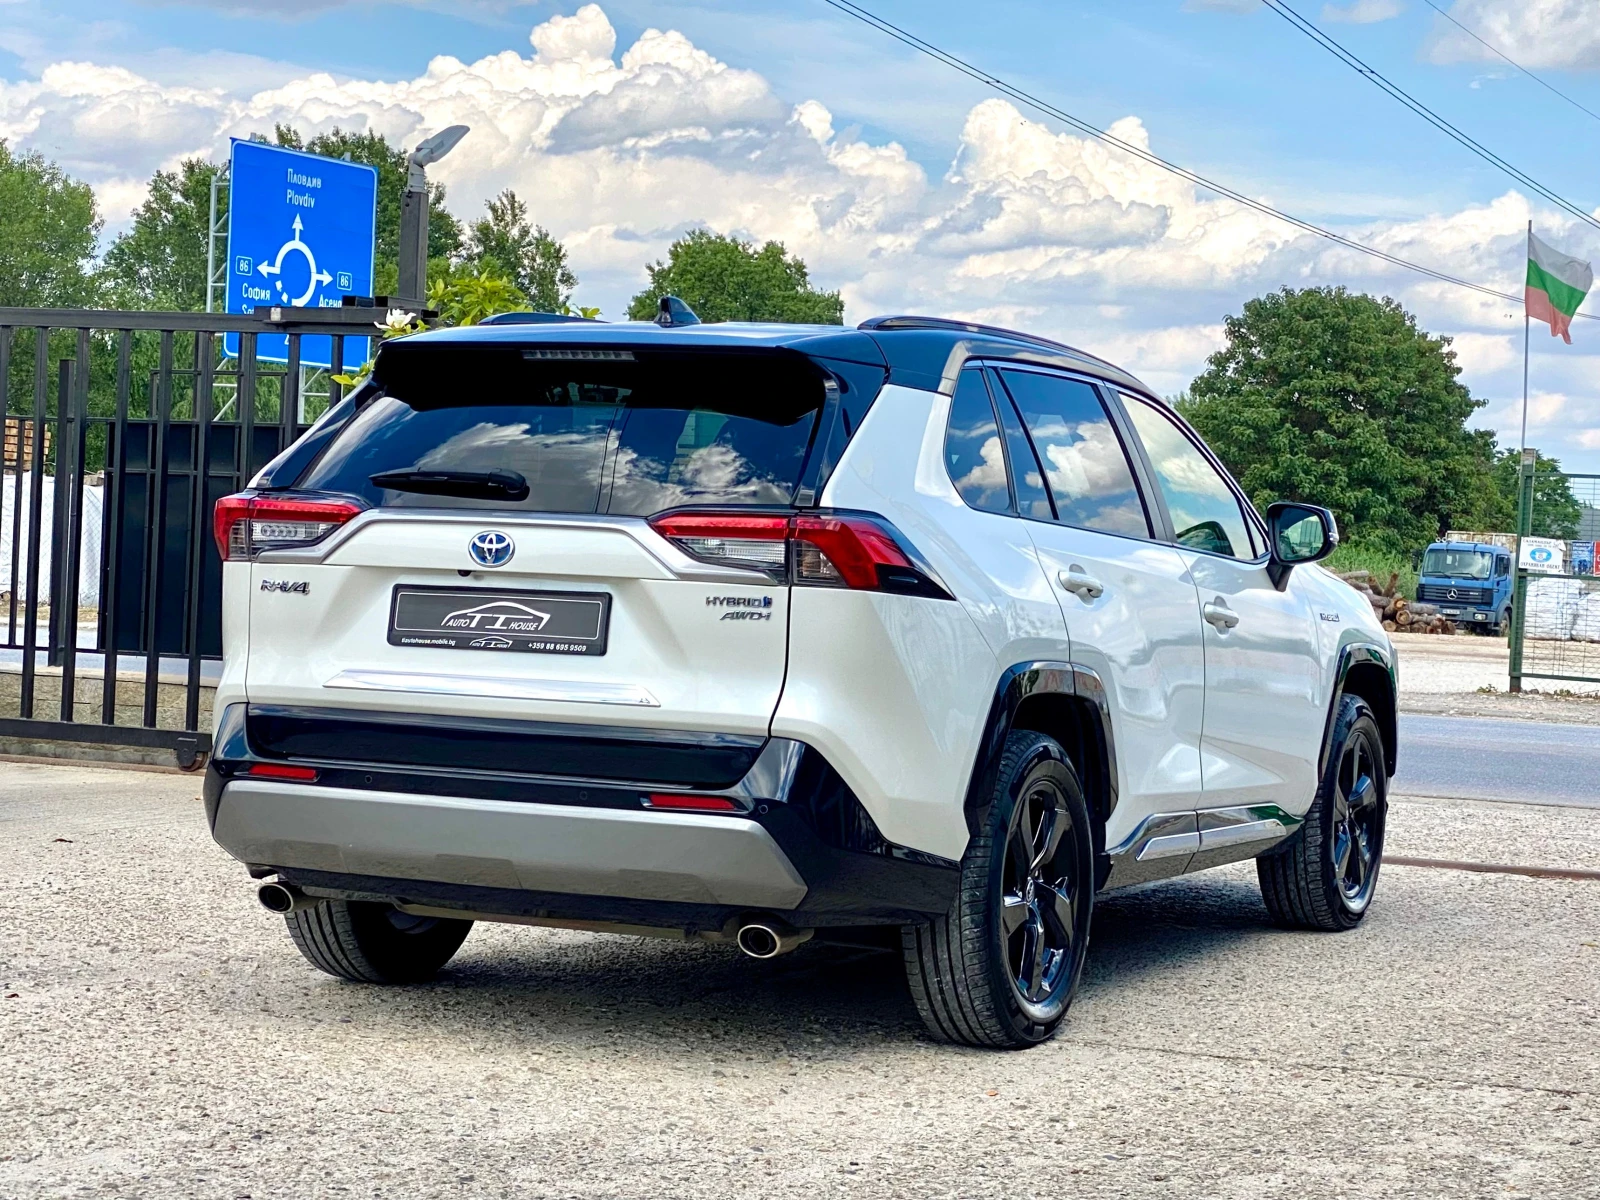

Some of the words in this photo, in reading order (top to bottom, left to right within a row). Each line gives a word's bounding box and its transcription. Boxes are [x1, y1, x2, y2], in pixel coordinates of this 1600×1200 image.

[287, 168, 322, 188] Пловдив
[286, 189, 315, 208] Plovdiv
[239, 260, 249, 272] 86
[340, 275, 349, 287] 86
[242, 283, 271, 301] София
[260, 580, 310, 595] RAV4
[705, 596, 761, 608] HYBRID
[446, 619, 470, 627] AUTO
[508, 622, 538, 631] HOUSE
[555, 643, 569, 651] 695
[569, 644, 587, 652] 9509
